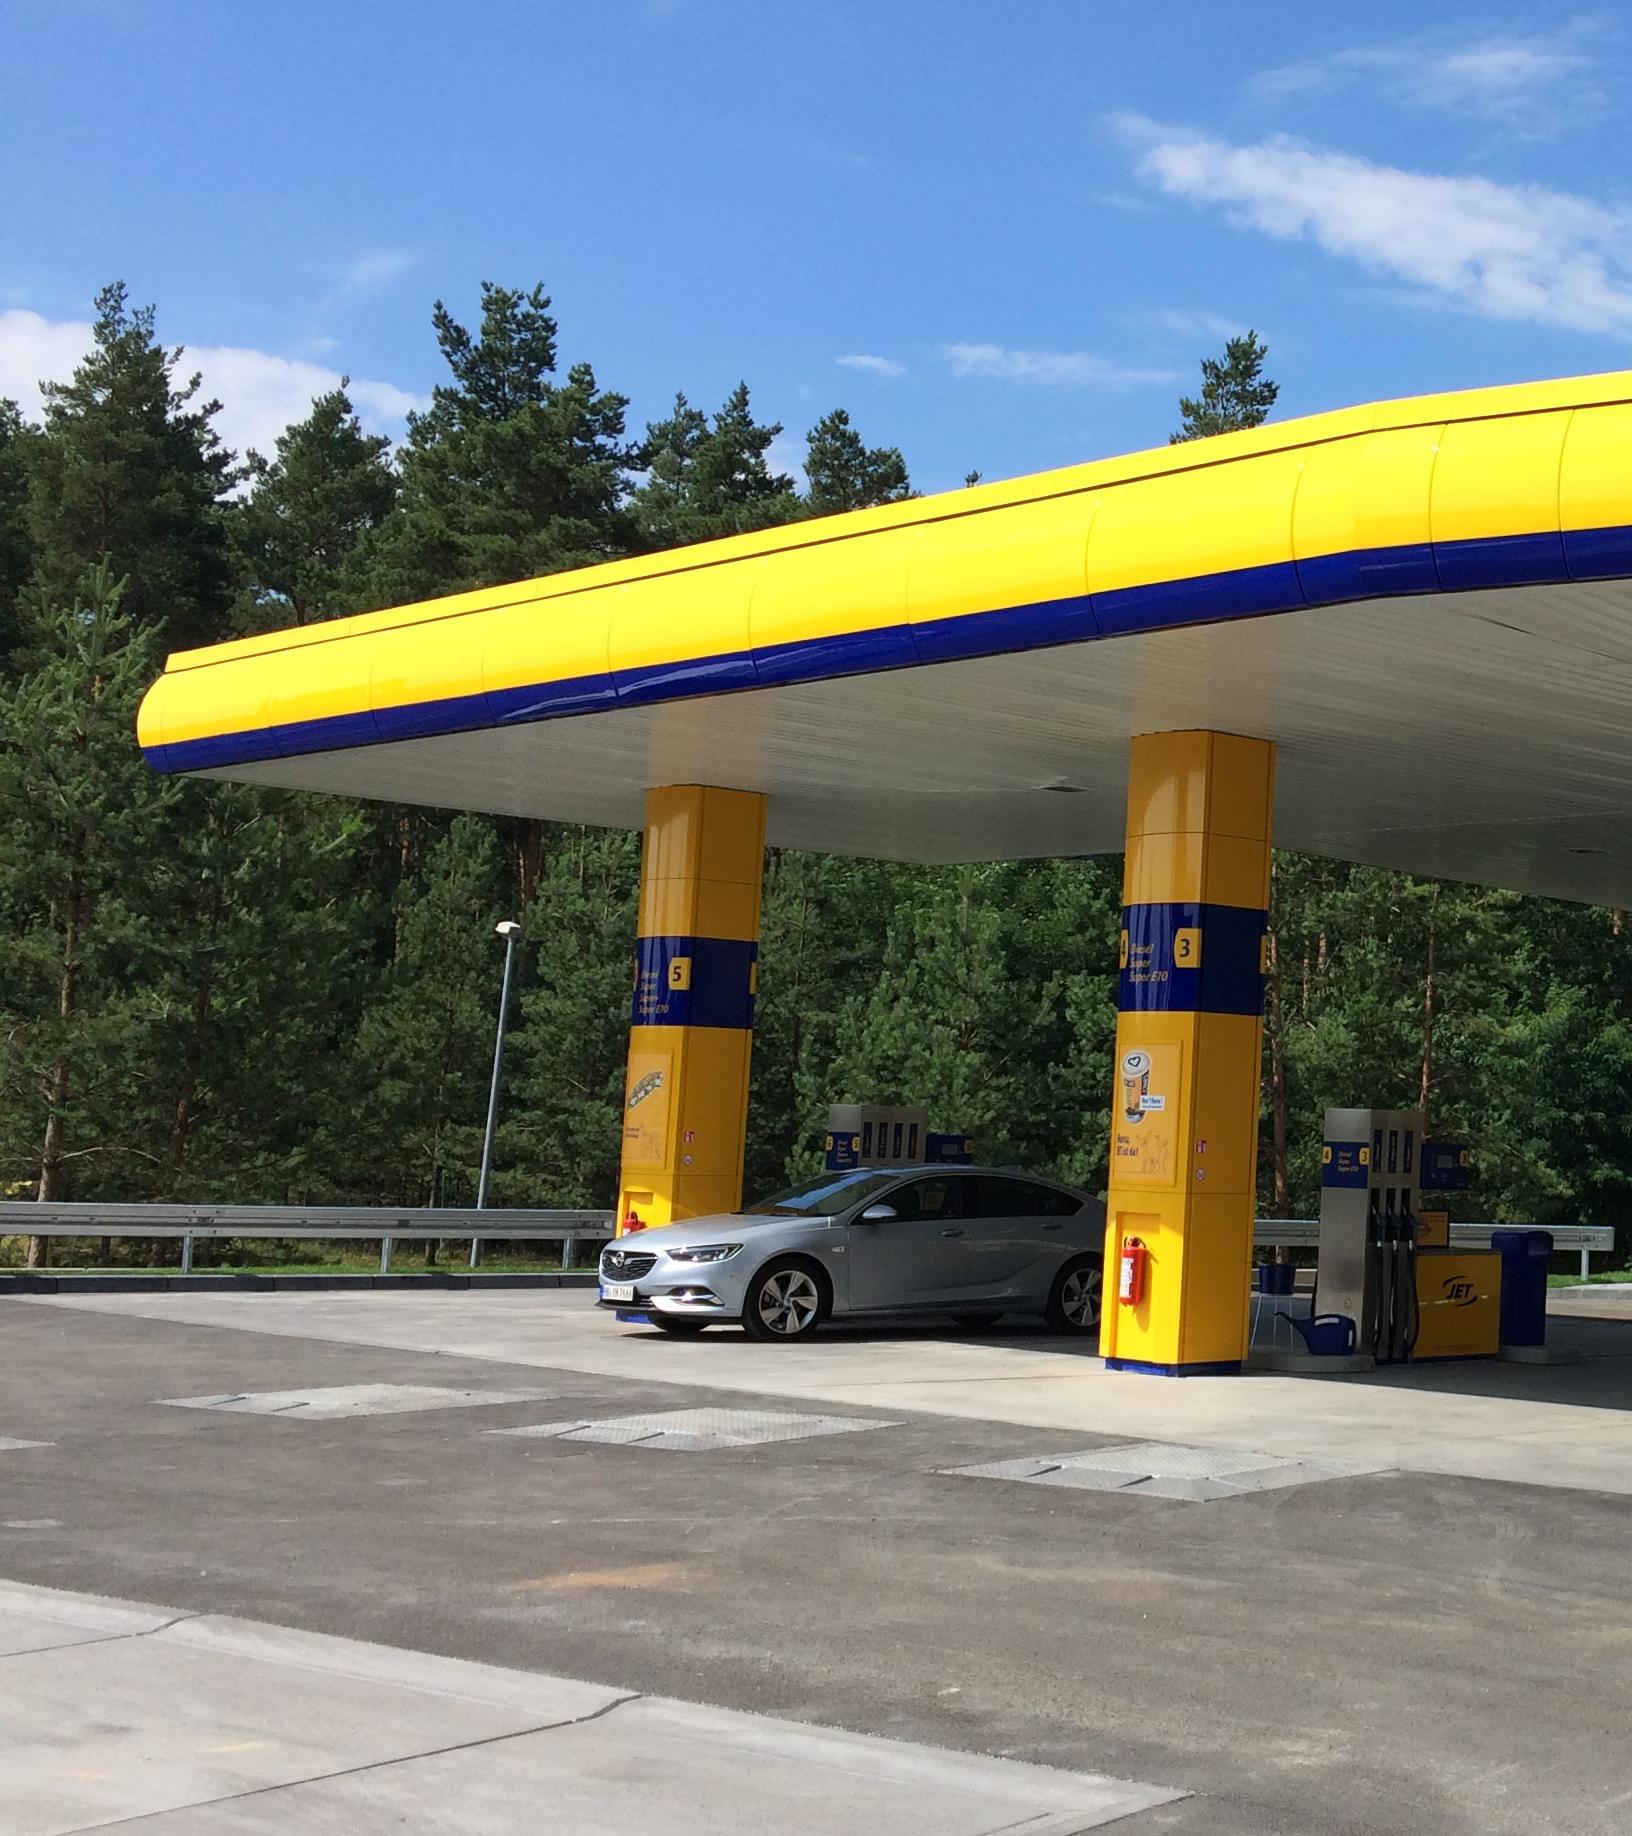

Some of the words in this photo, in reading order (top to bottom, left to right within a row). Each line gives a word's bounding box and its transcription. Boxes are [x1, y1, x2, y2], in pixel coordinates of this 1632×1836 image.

[1130, 943, 1154, 955] Diesel
[1179, 938, 1190, 958] 3
[1129, 958, 1151, 969] Super
[672, 966, 682, 982] 5
[1129, 972, 1150, 986] Super
[1150, 971, 1169, 982] E10
[1361, 1151, 1367, 1162] 3
[1446, 1283, 1474, 1299] JET
